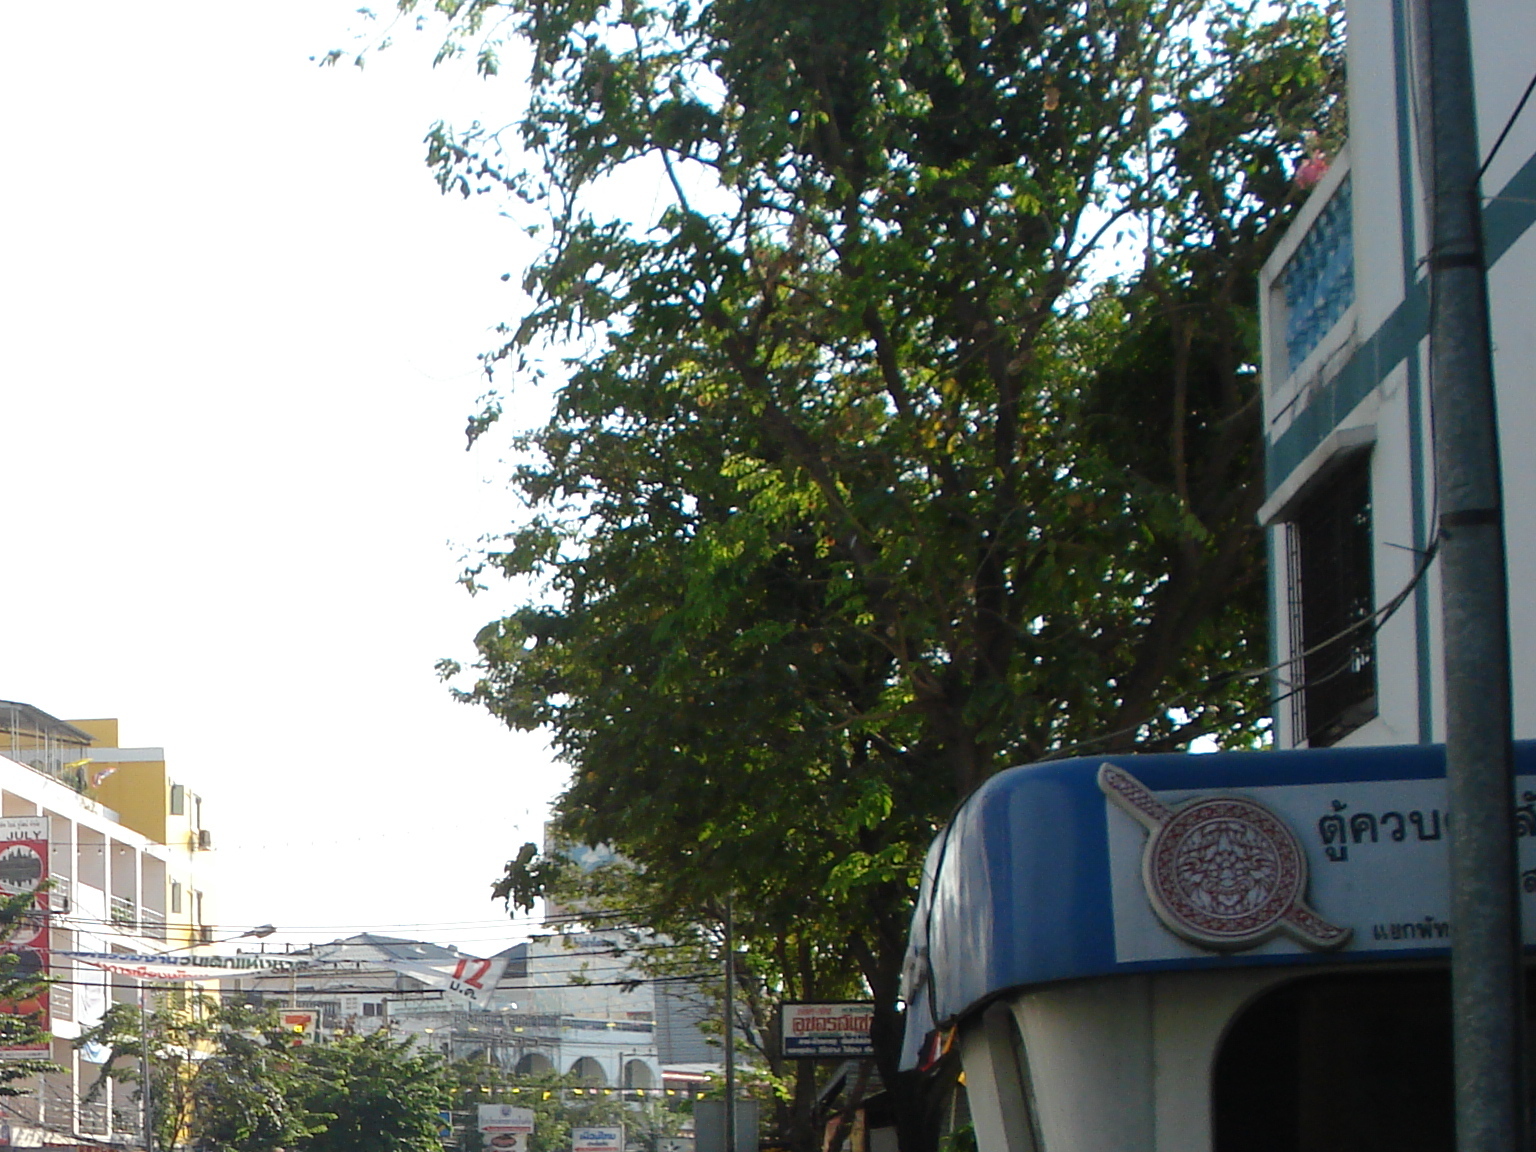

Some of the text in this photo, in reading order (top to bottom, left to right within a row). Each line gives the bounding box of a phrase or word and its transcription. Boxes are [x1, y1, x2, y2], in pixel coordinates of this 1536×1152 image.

[6, 830, 42, 841] JULY
[1318, 799, 1450, 862] ตู้ควบ
[452, 958, 492, 990] 12
